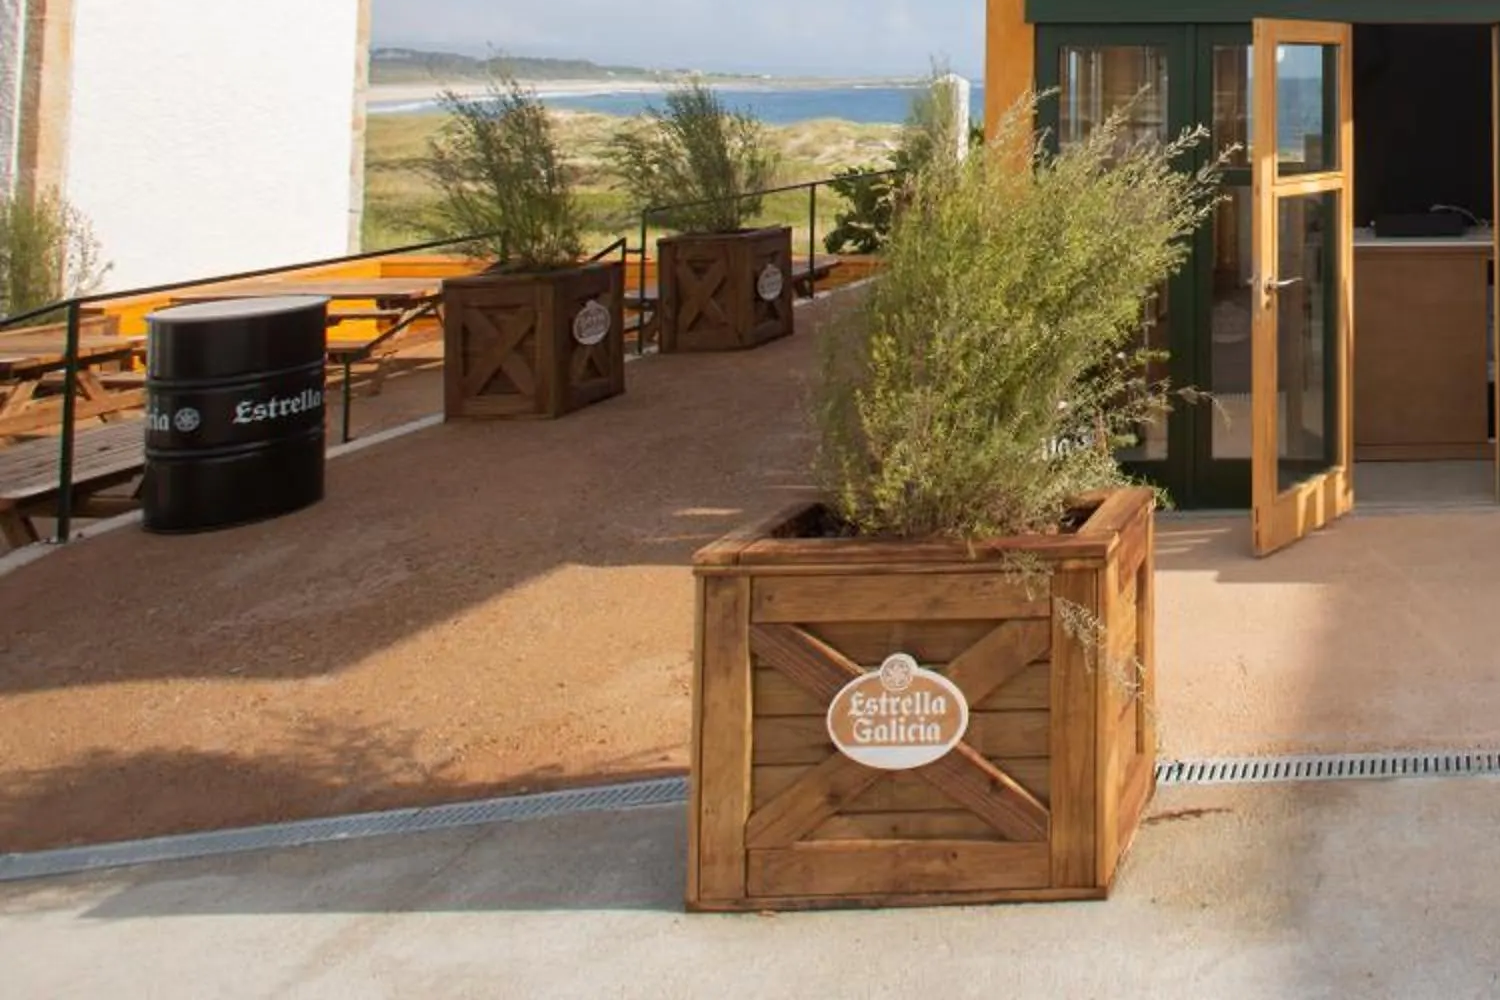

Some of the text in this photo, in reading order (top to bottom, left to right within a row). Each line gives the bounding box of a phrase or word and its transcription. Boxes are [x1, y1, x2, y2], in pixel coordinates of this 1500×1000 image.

[232, 388, 321, 423] Estrella
[847, 691, 946, 717] Estrella
[853, 717, 940, 743] Galicia
